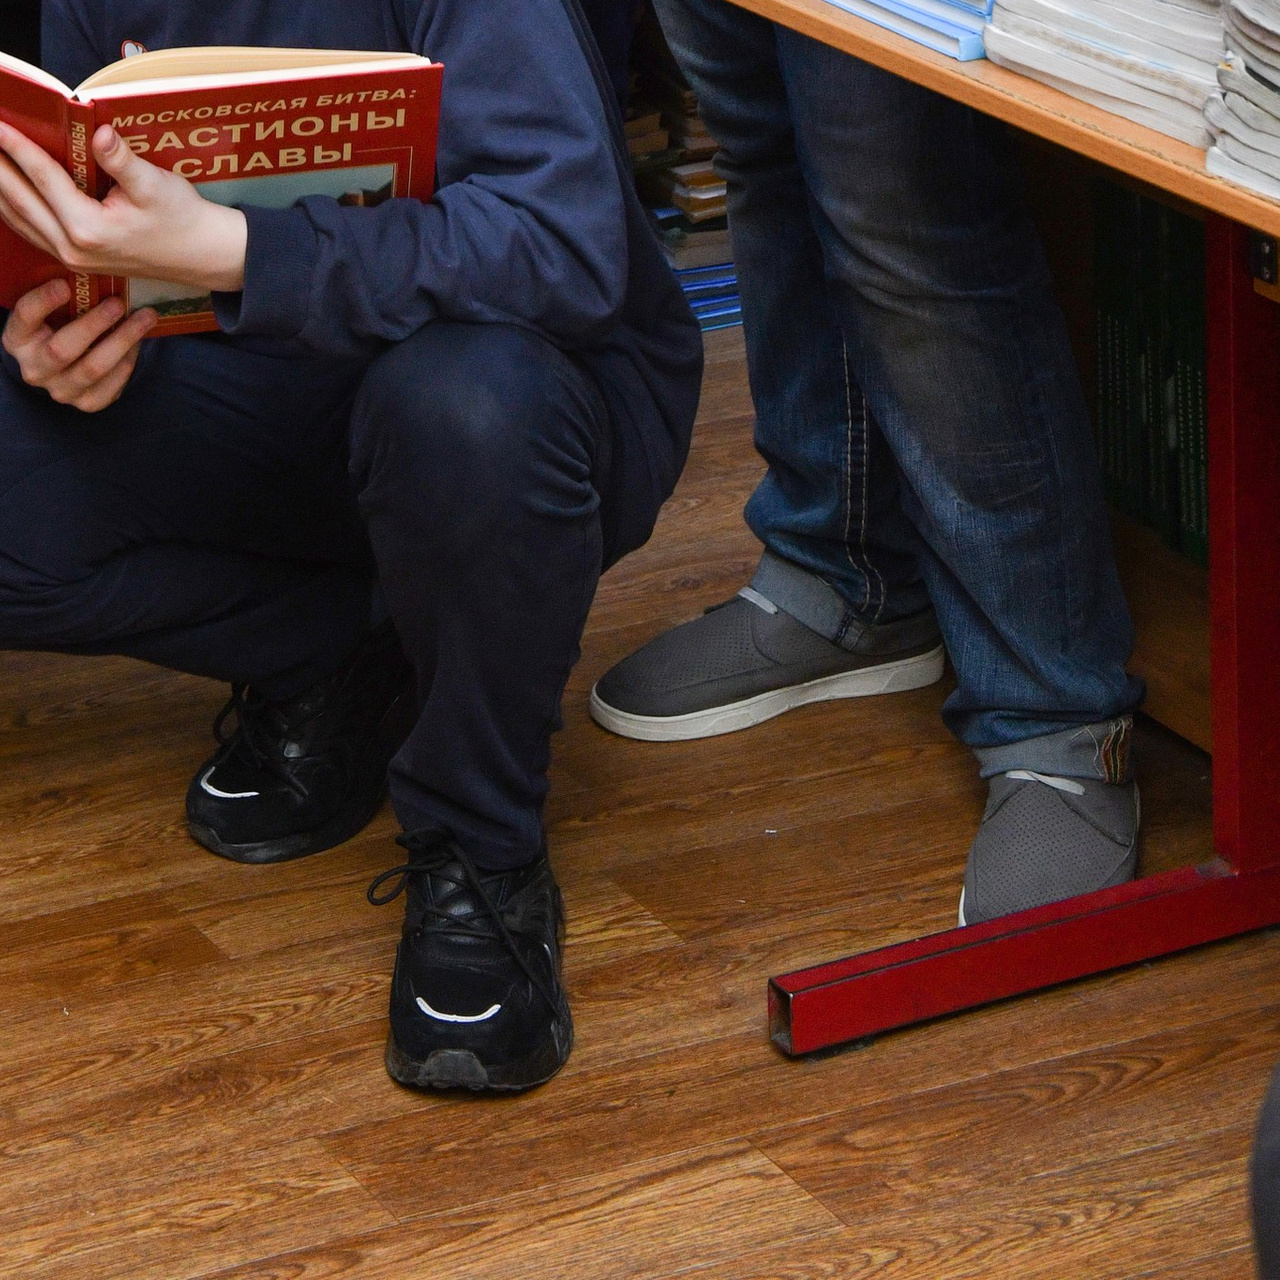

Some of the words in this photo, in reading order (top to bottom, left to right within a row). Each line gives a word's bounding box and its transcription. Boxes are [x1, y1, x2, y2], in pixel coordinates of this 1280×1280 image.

[110, 95, 308, 128] МОСКОВСКАЯ
[315, 87, 418, 108] БИТВА:
[73, 121, 86, 162] СЛАВЫ
[120, 107, 408, 156] БАСТИОНЫ
[172, 142, 354, 178] СЛАВЫ
